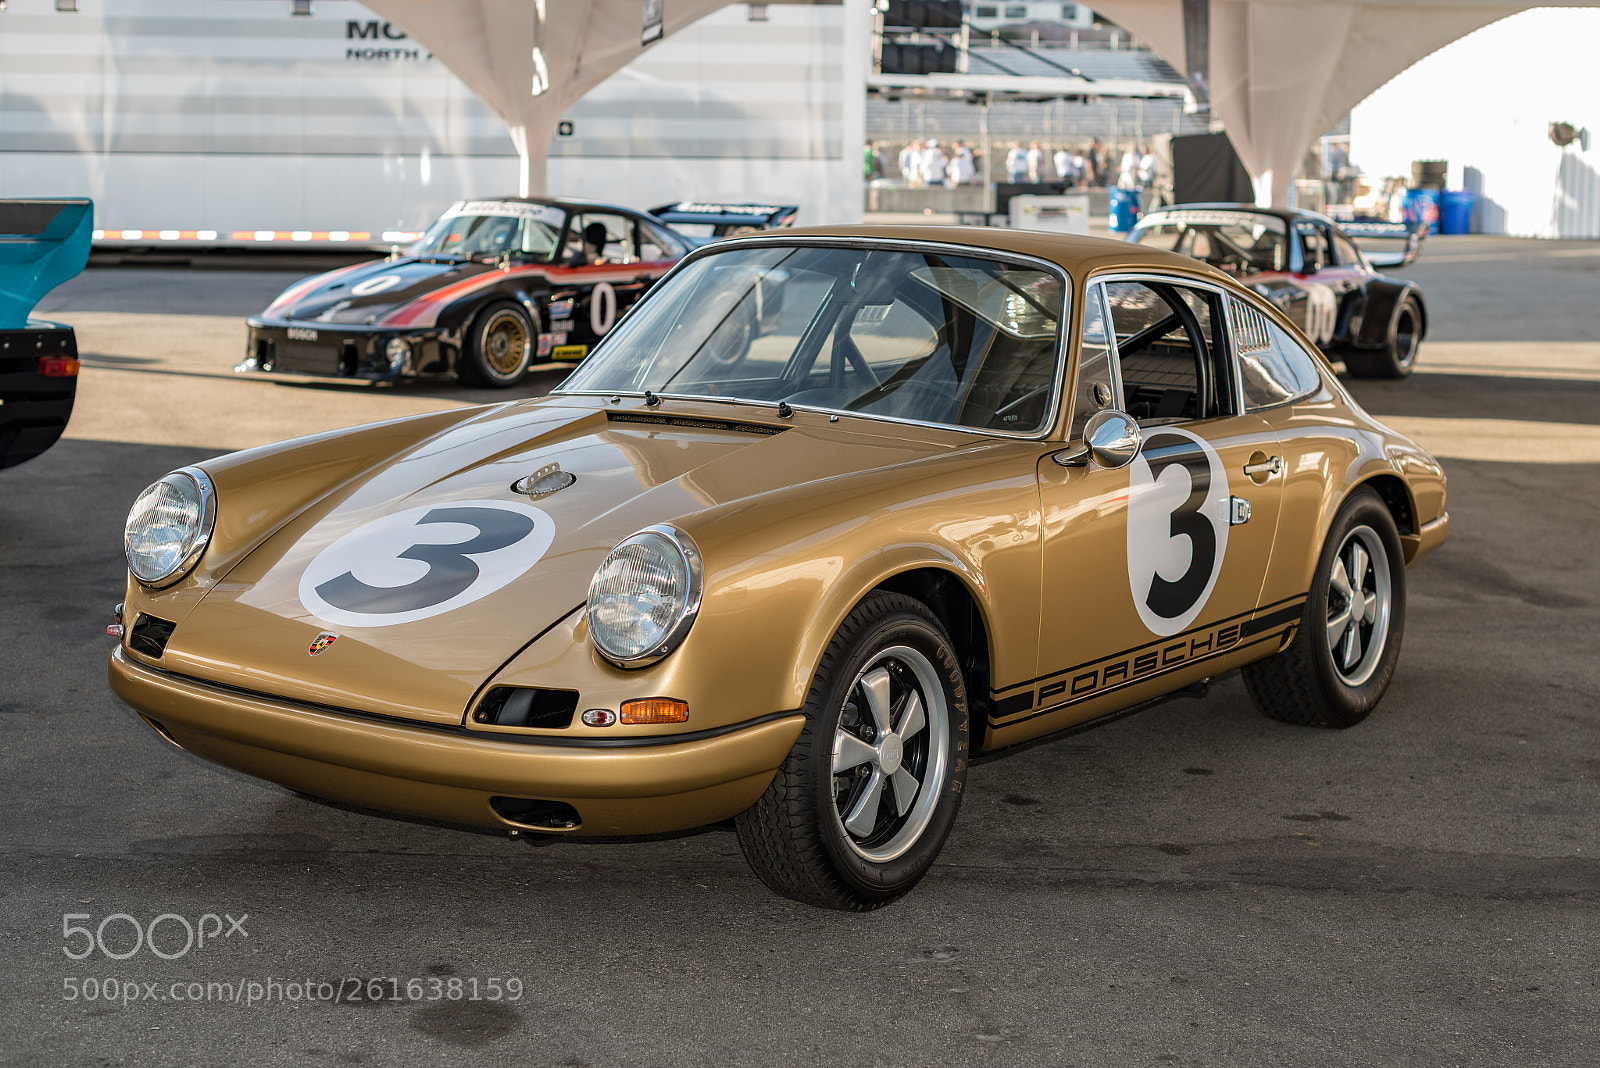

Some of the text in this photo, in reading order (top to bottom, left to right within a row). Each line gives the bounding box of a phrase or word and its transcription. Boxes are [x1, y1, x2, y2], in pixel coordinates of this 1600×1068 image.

[346, 48, 418, 59] NORTH
[287, 327, 318, 341] BOSCH
[590, 282, 616, 336] 0
[1140, 433, 1216, 619] 3
[314, 507, 535, 614] 3
[1037, 624, 1240, 707] PORSCHE
